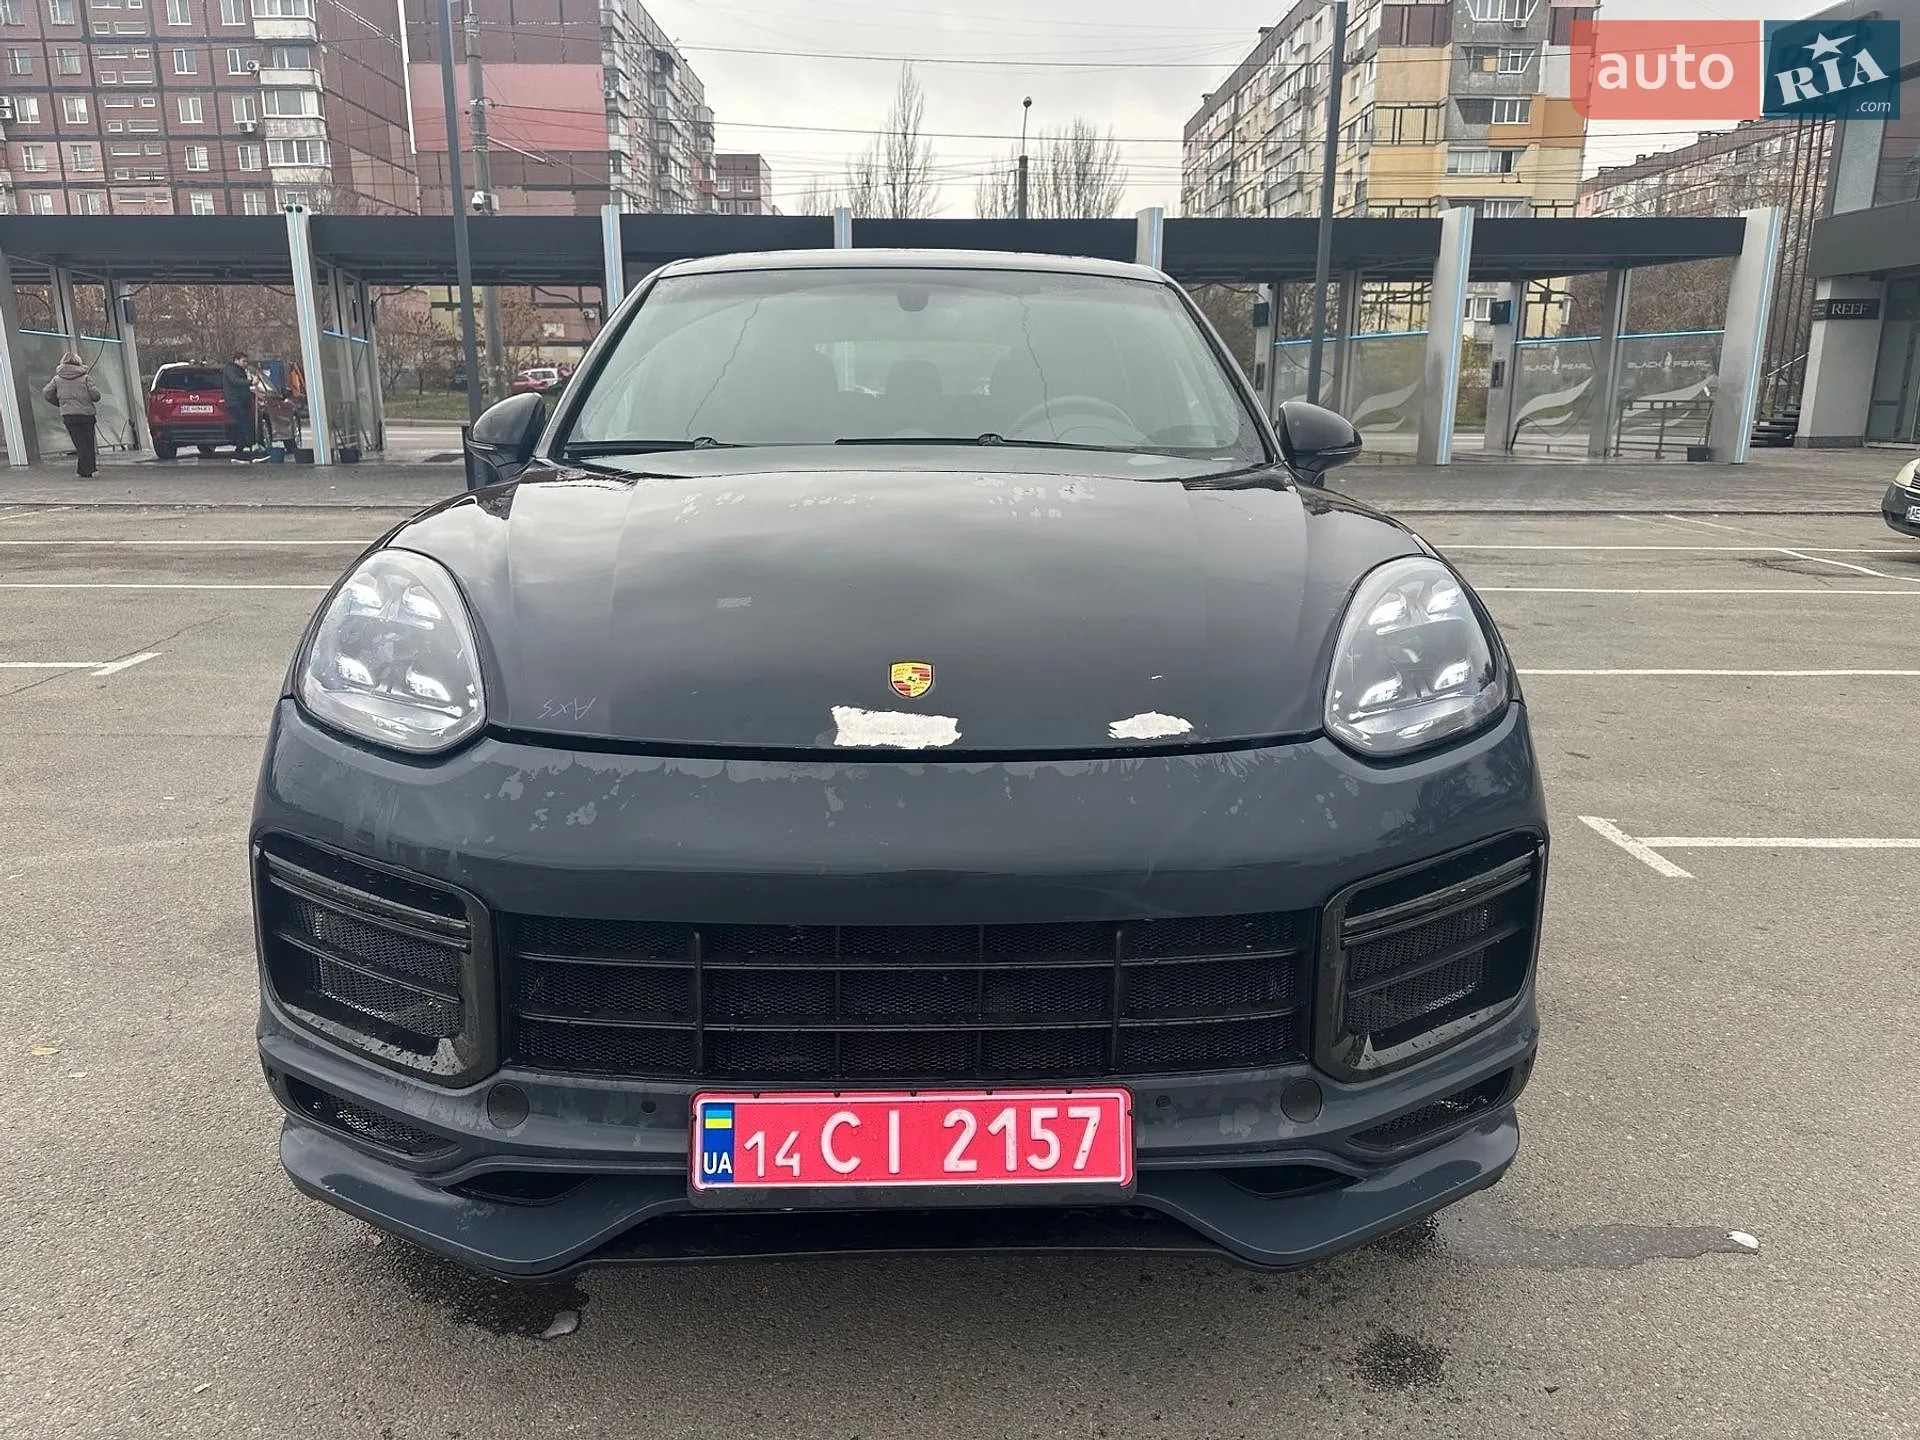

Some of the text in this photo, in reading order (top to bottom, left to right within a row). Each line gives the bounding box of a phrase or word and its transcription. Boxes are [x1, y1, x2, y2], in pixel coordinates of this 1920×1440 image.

[1831, 303, 1870, 315] REEF
[1627, 361, 1662, 369] BLACK
[743, 1130, 801, 1177] 14
[942, 1106, 1101, 1172] 2157
[702, 1151, 733, 1175] UA
